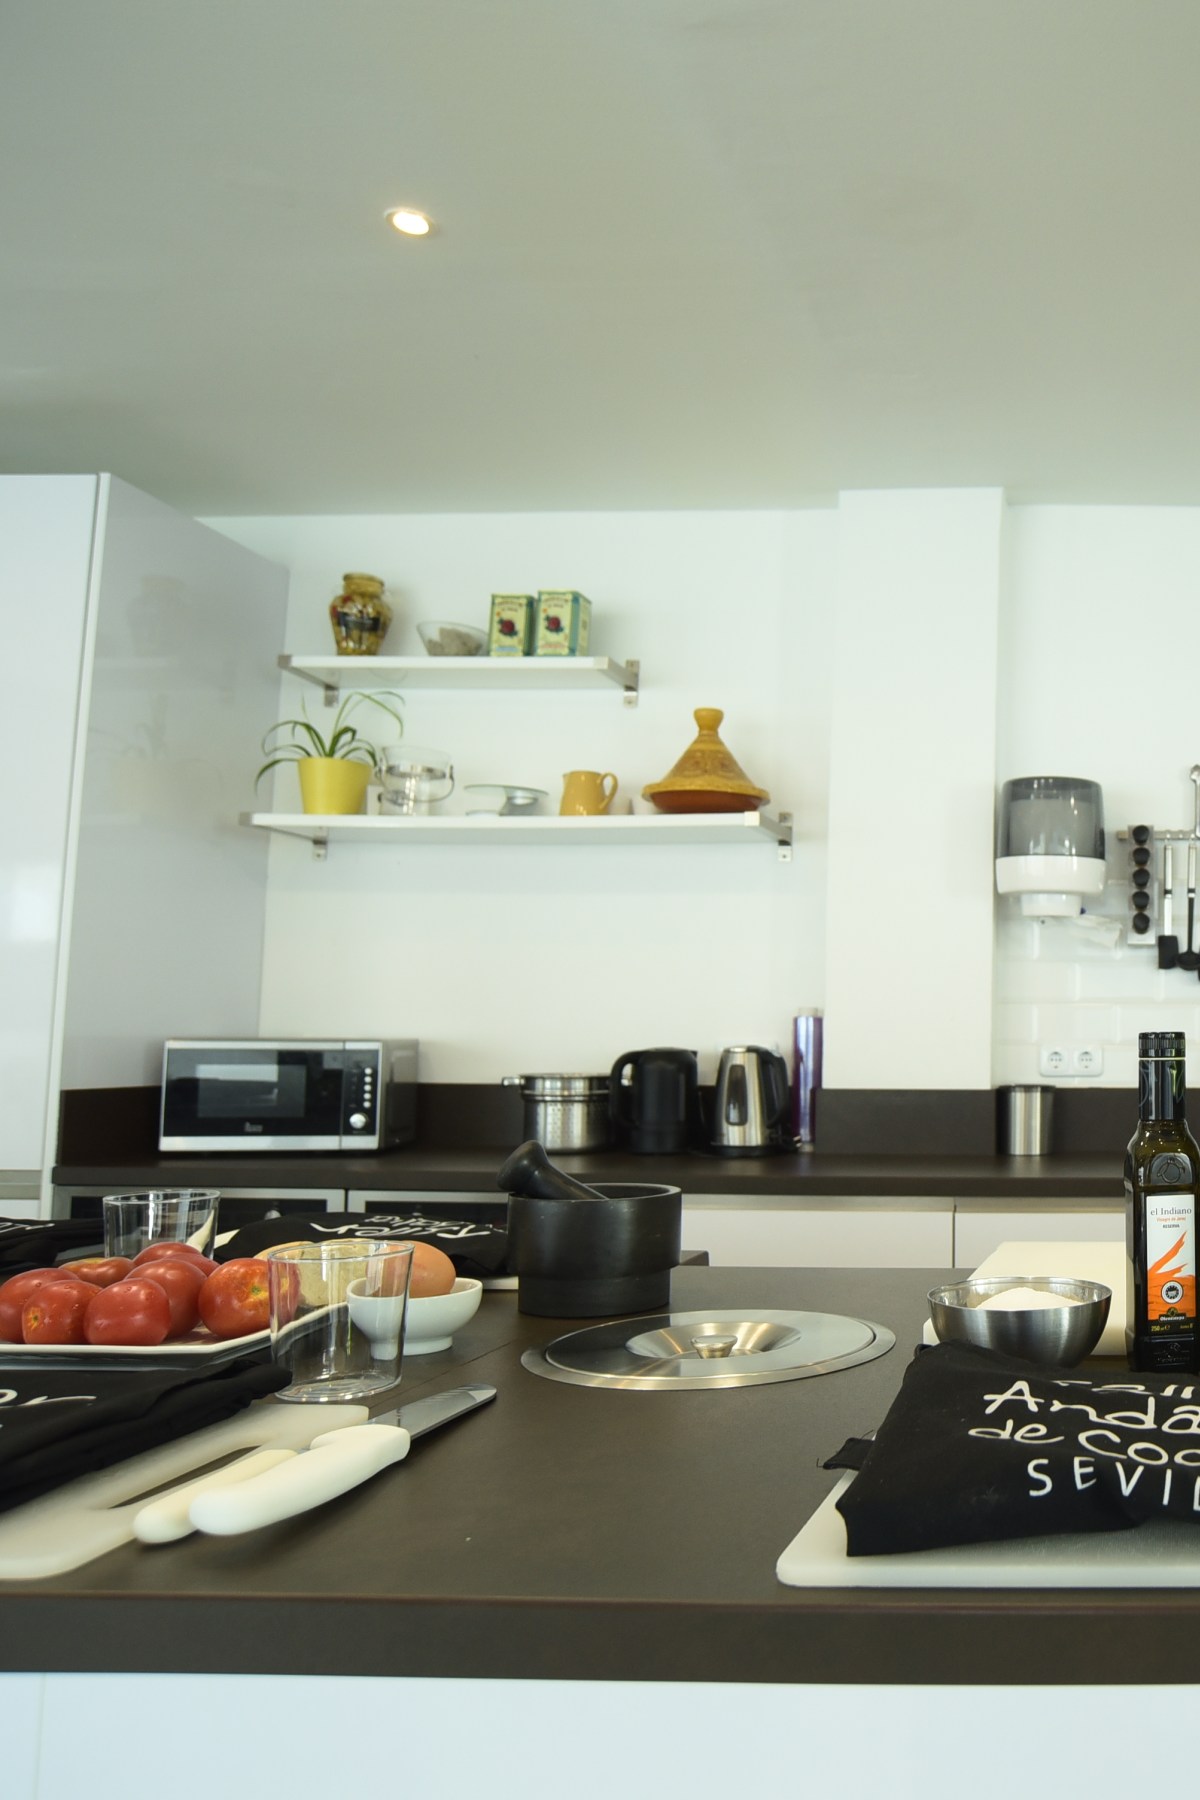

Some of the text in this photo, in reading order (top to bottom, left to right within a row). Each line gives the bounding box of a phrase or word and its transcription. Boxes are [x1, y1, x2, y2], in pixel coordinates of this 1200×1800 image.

[1150, 1206, 1192, 1216] el Indiano
[968, 1418, 1065, 1445] de
